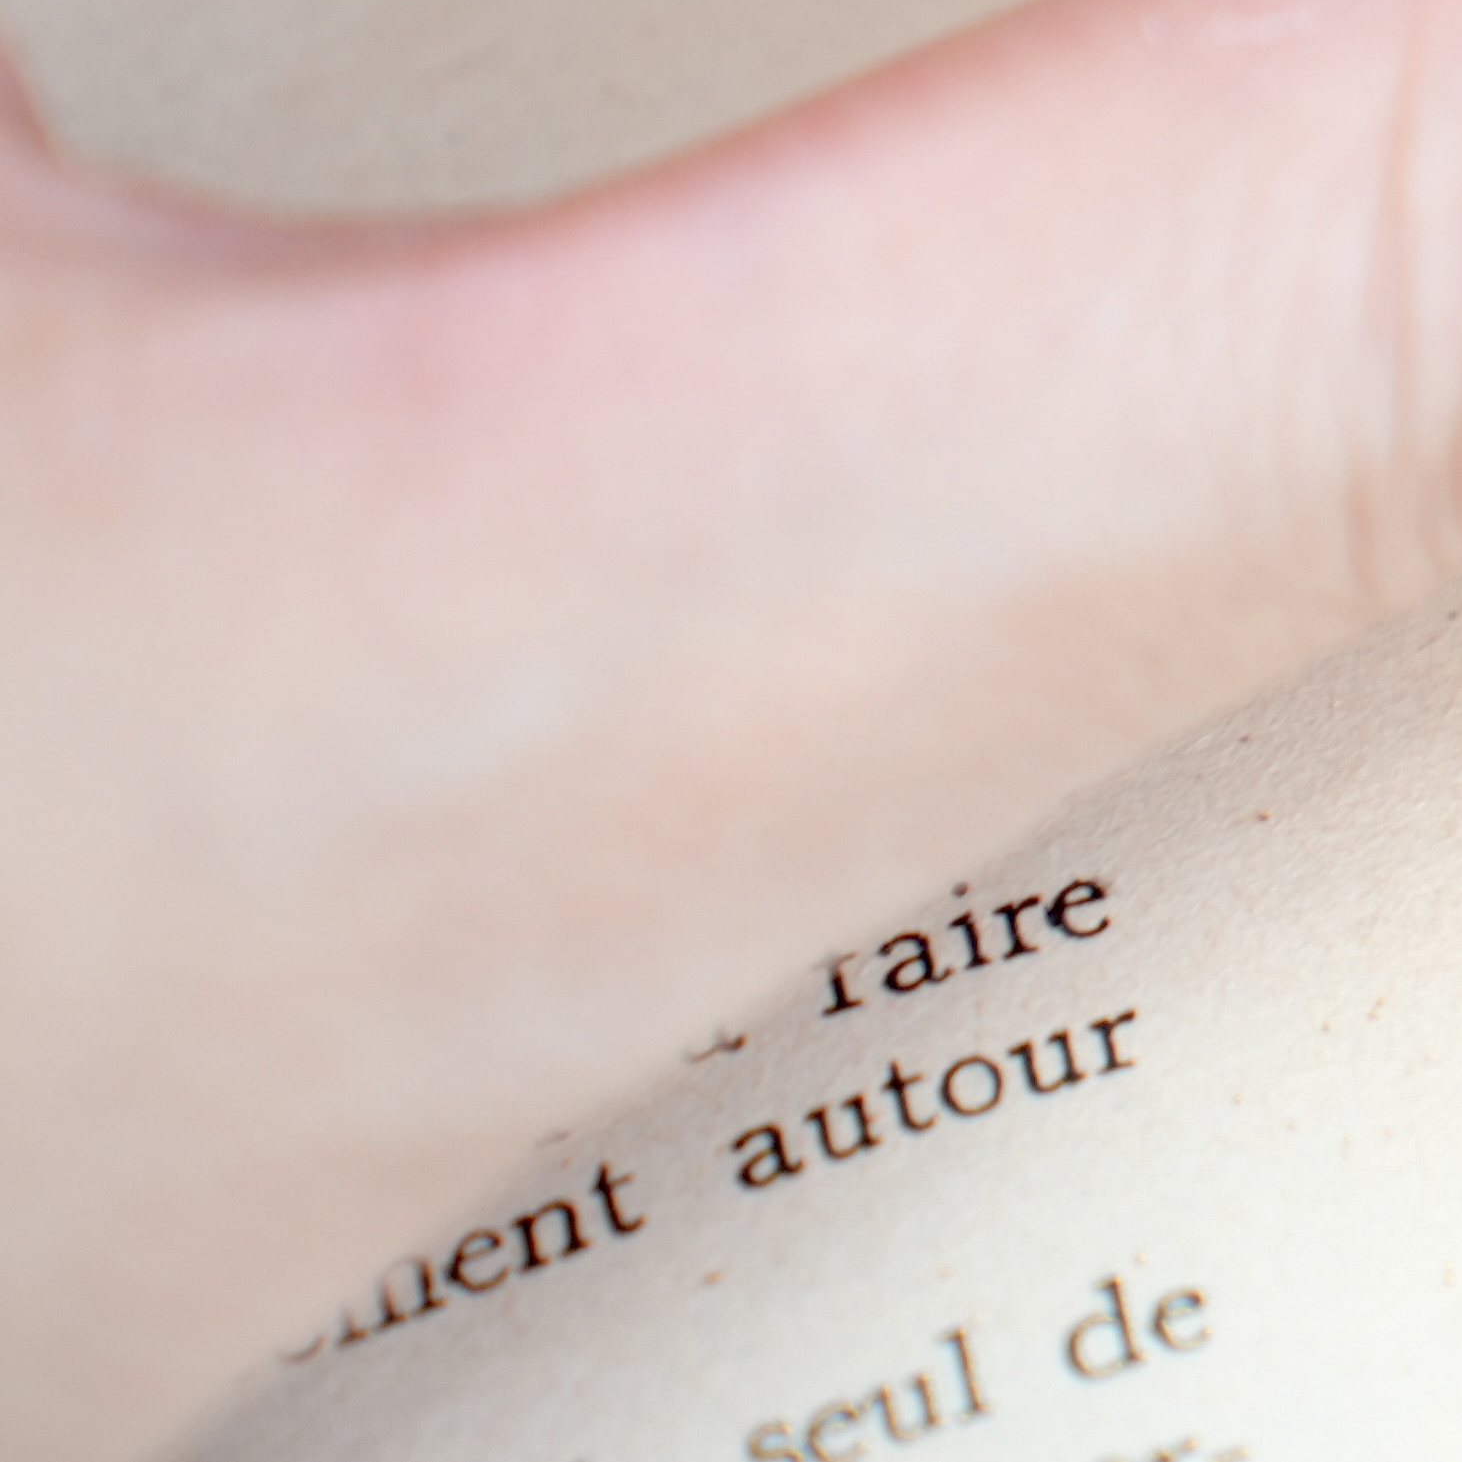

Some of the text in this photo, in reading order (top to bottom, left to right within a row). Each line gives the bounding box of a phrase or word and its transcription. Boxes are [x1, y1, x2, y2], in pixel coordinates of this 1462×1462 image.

[278, 1003, 1142, 1367] ment autour
[742, 1270, 1211, 1462] seul de
